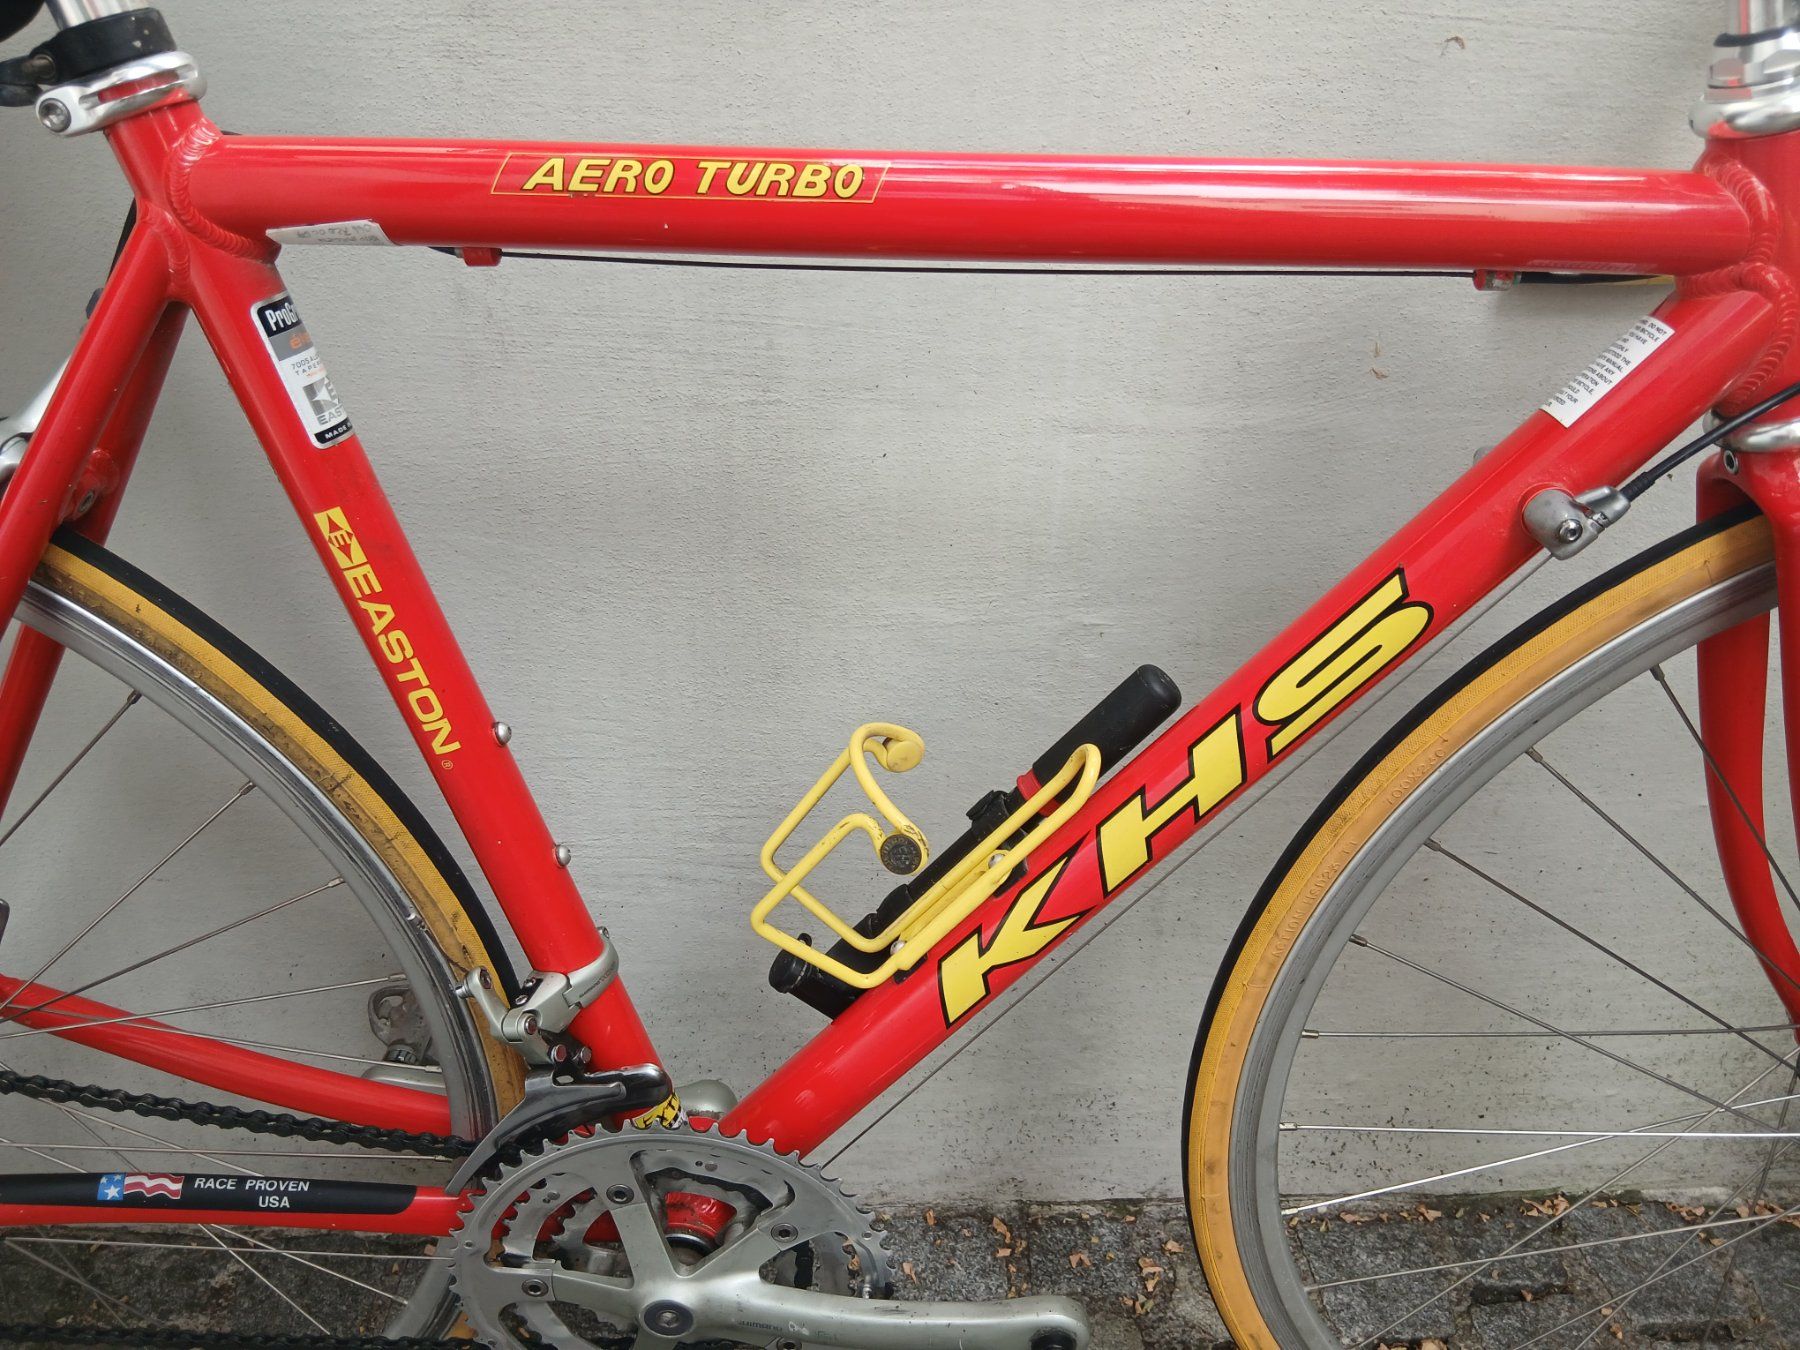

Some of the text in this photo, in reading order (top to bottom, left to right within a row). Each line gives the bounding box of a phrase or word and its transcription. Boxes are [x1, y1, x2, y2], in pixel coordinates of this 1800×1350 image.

[521, 157, 864, 199] AERO TURBO
[343, 563, 462, 755] EASTON
[938, 565, 1434, 1029] KHS
[194, 1177, 310, 1192] RACE PROVEN
[258, 1195, 290, 1208] USA
